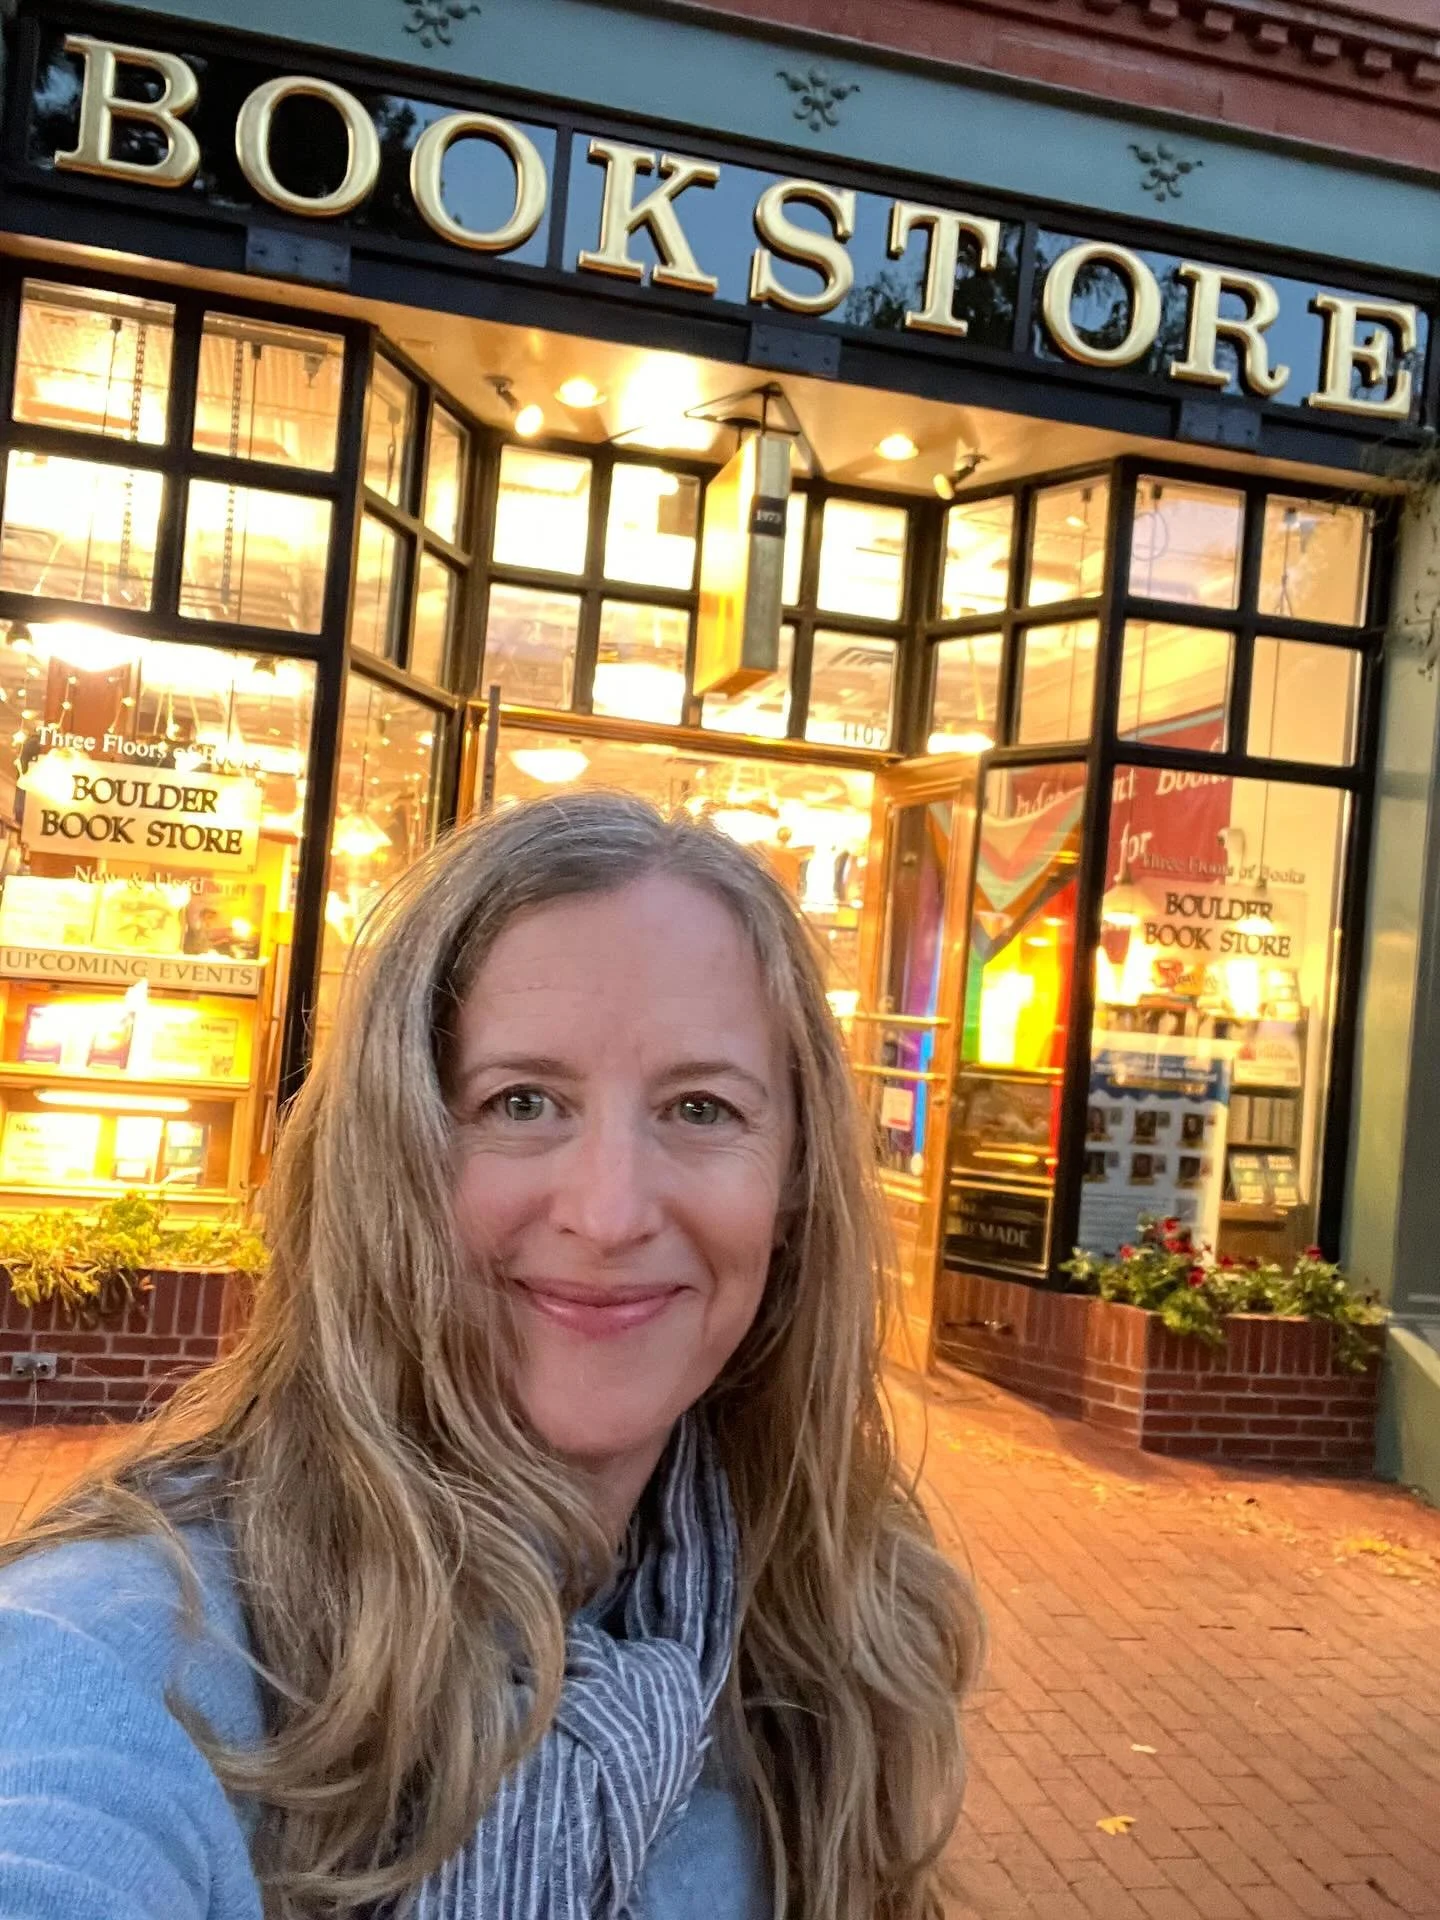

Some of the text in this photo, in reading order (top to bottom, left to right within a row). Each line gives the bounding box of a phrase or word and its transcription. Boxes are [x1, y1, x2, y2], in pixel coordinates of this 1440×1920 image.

[54, 34, 1419, 418] BOOKSTORE
[36, 724, 96, 751] Three
[102, 732, 167, 759] Floors
[843, 722, 888, 746] 1107
[71, 775, 218, 814] BOULDER
[40, 809, 243, 855] BOOK STORE
[1113, 822, 1154, 884] for
[1164, 892, 1273, 922] BOULDER
[1144, 922, 1292, 958] BOOK STORE
[5, 949, 254, 986] UPCOMING EVENTS
